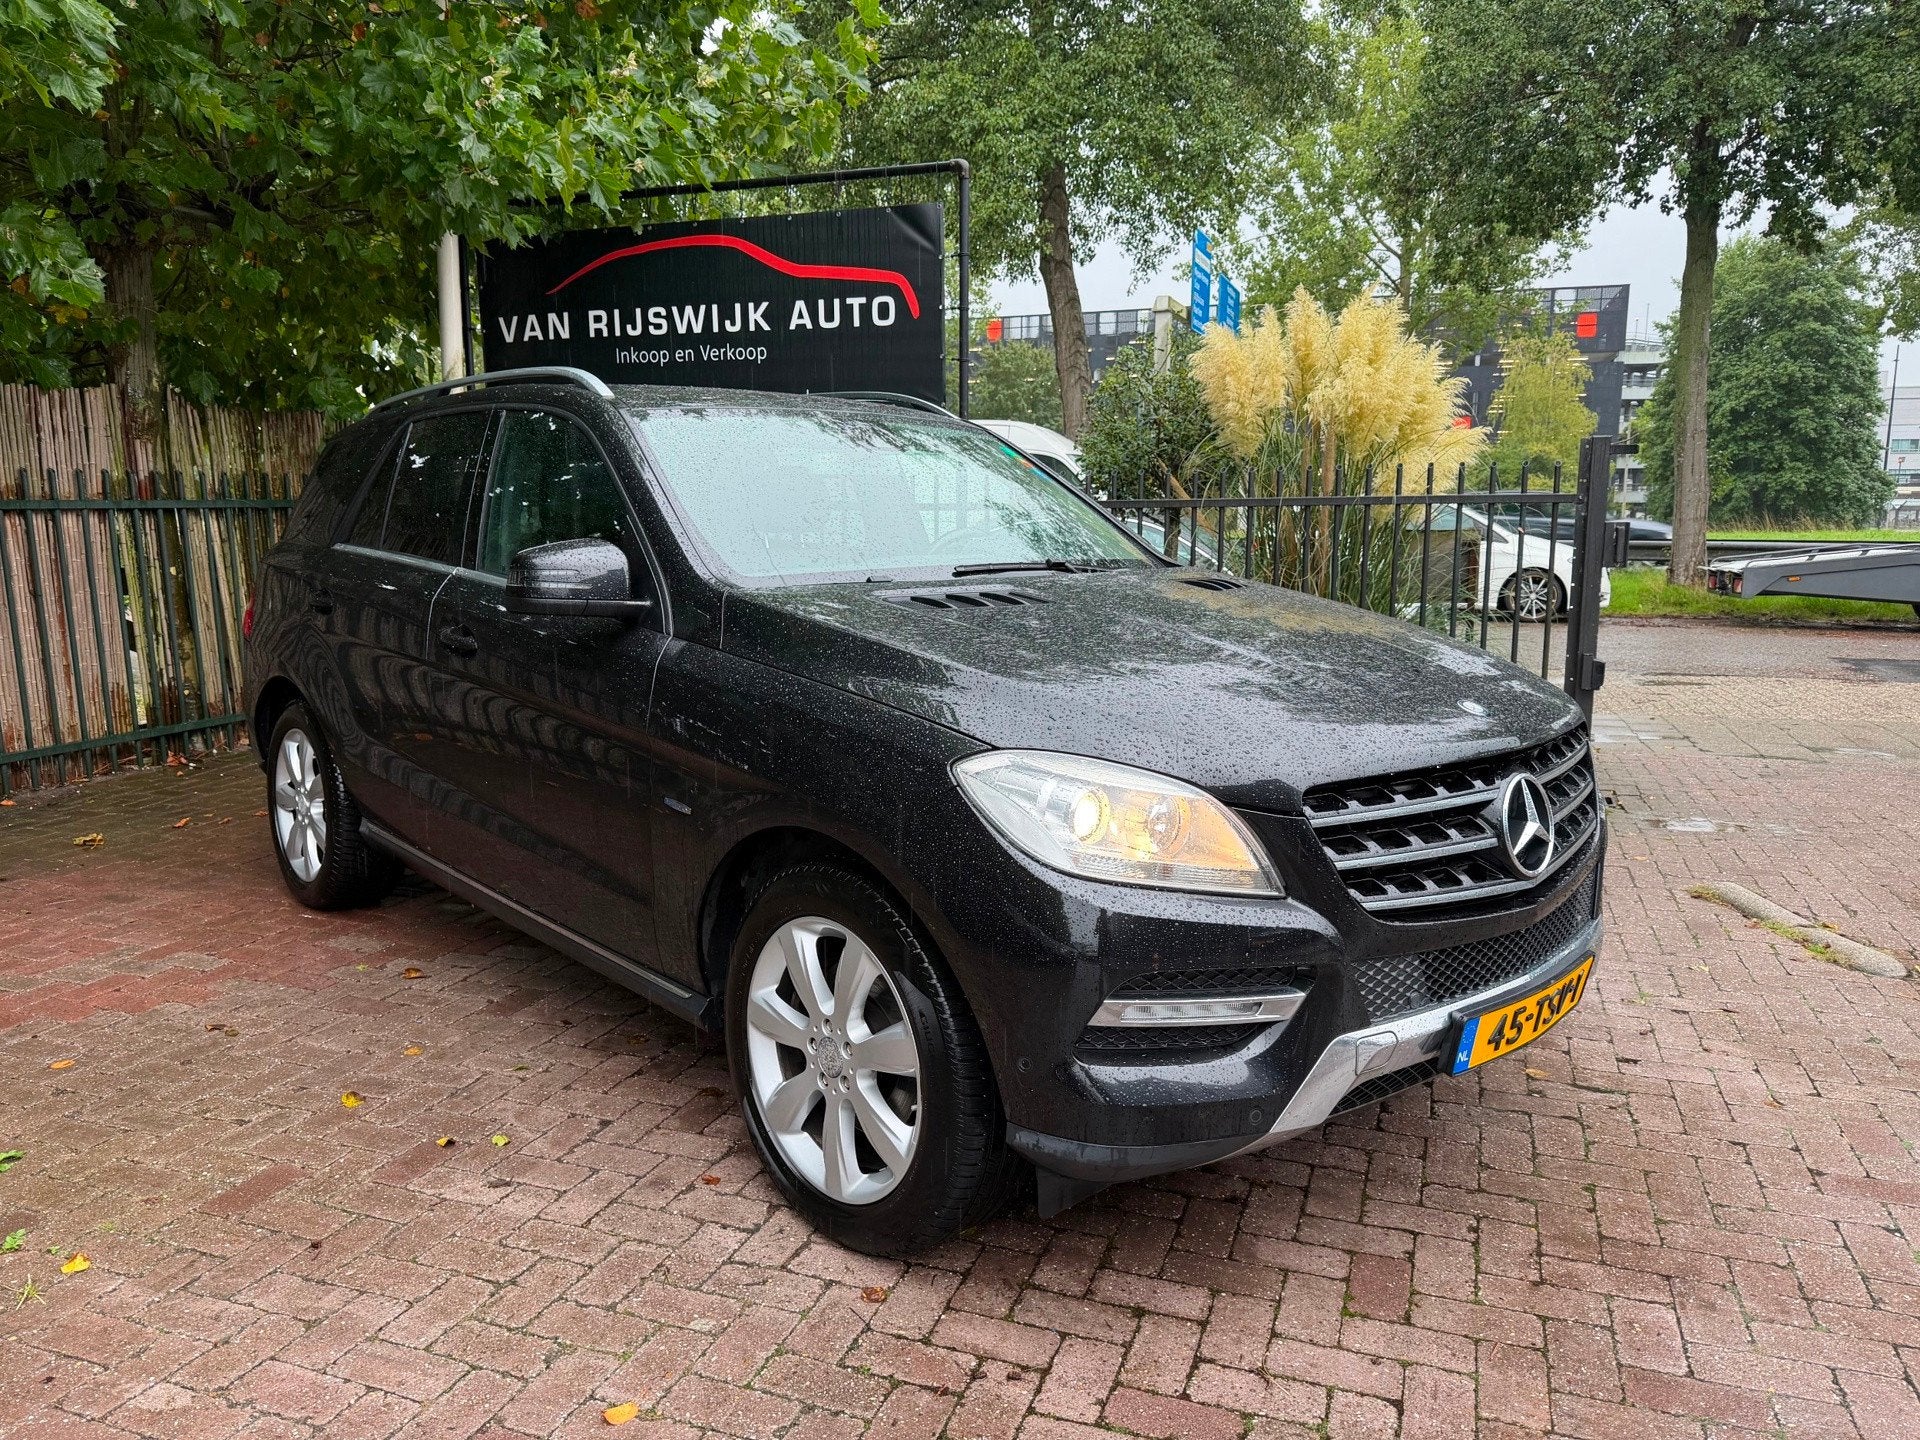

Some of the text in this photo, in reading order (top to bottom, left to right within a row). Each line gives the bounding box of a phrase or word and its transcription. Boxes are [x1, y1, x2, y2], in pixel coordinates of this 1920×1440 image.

[499, 296, 895, 342] VAN RIJSWIJK AUTO
[617, 343, 767, 366] Inkoop en Verkoop
[1457, 1051, 1469, 1063] NL
